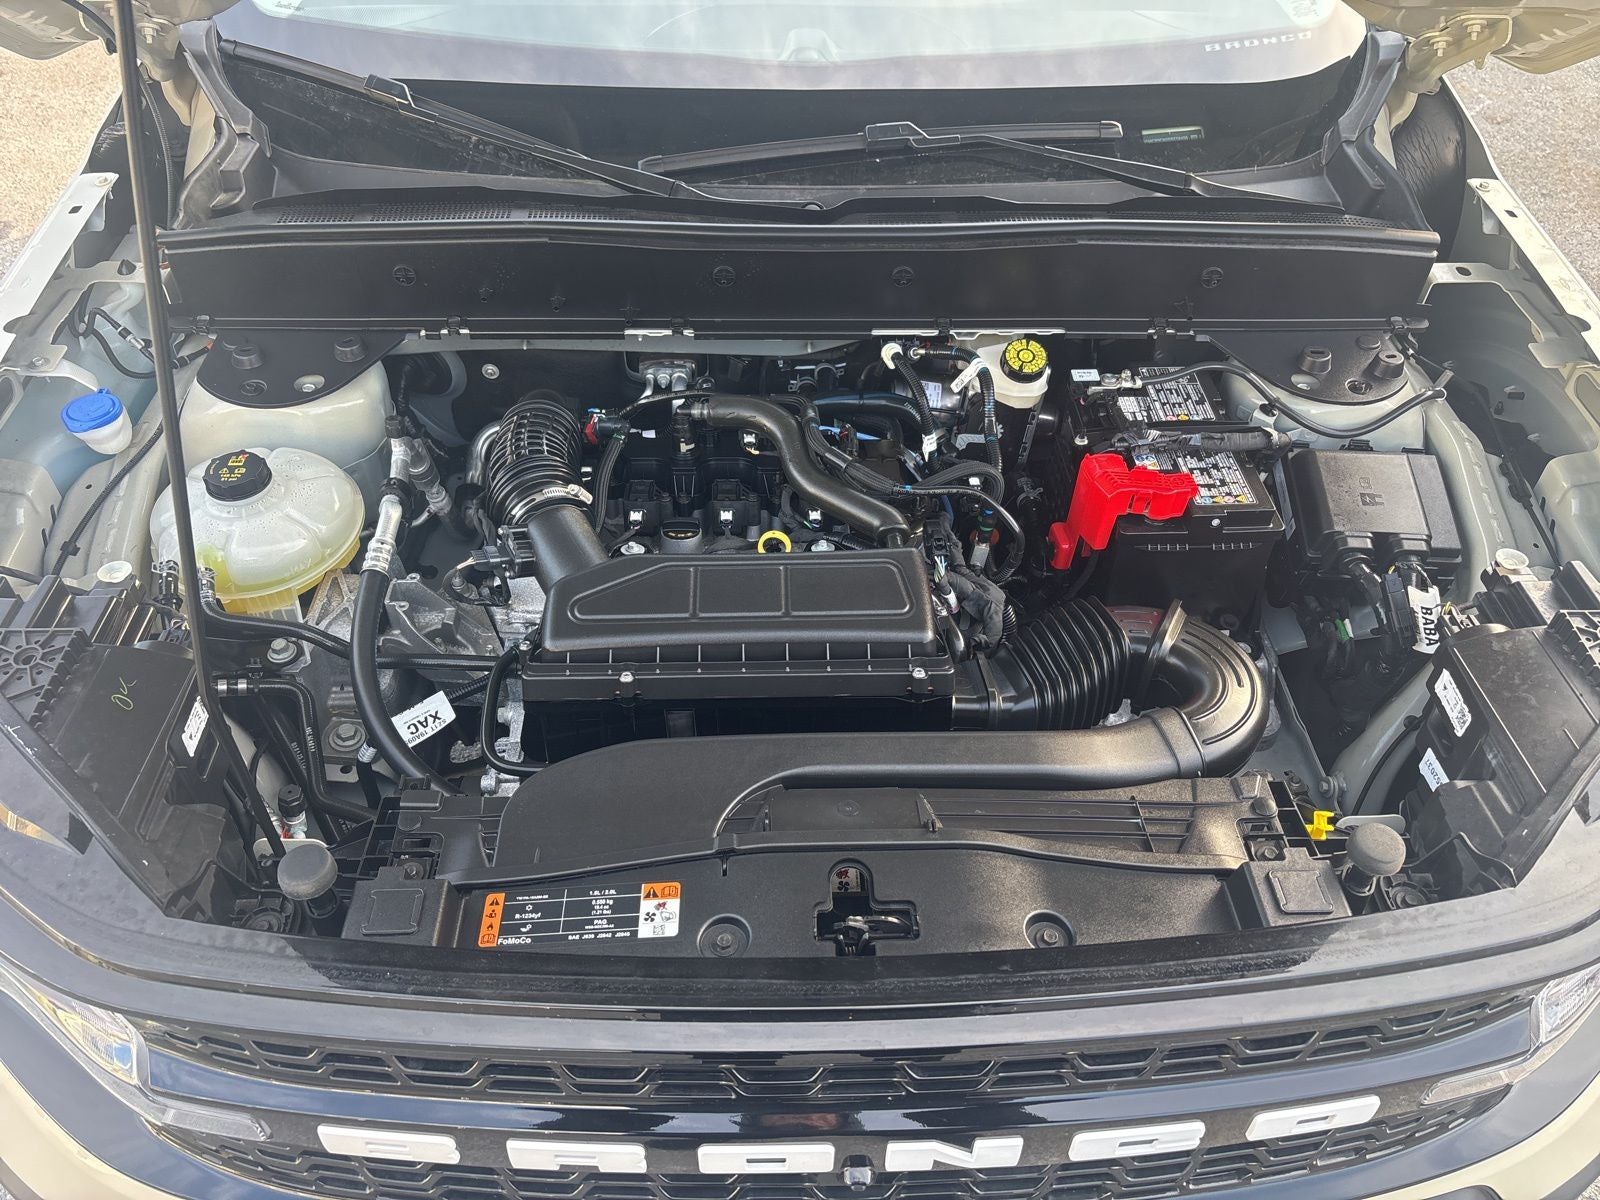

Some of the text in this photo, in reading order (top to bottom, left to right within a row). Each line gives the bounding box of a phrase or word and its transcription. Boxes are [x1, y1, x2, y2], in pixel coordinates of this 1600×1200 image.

[1204, 30, 1312, 52] BRONCO
[1420, 606, 1439, 646] BABA
[406, 710, 442, 735] XAC
[514, 912, 542, 920] R-1234yf
[498, 937, 532, 945] FoMoCo
[316, 1095, 1382, 1174] BRONCO
